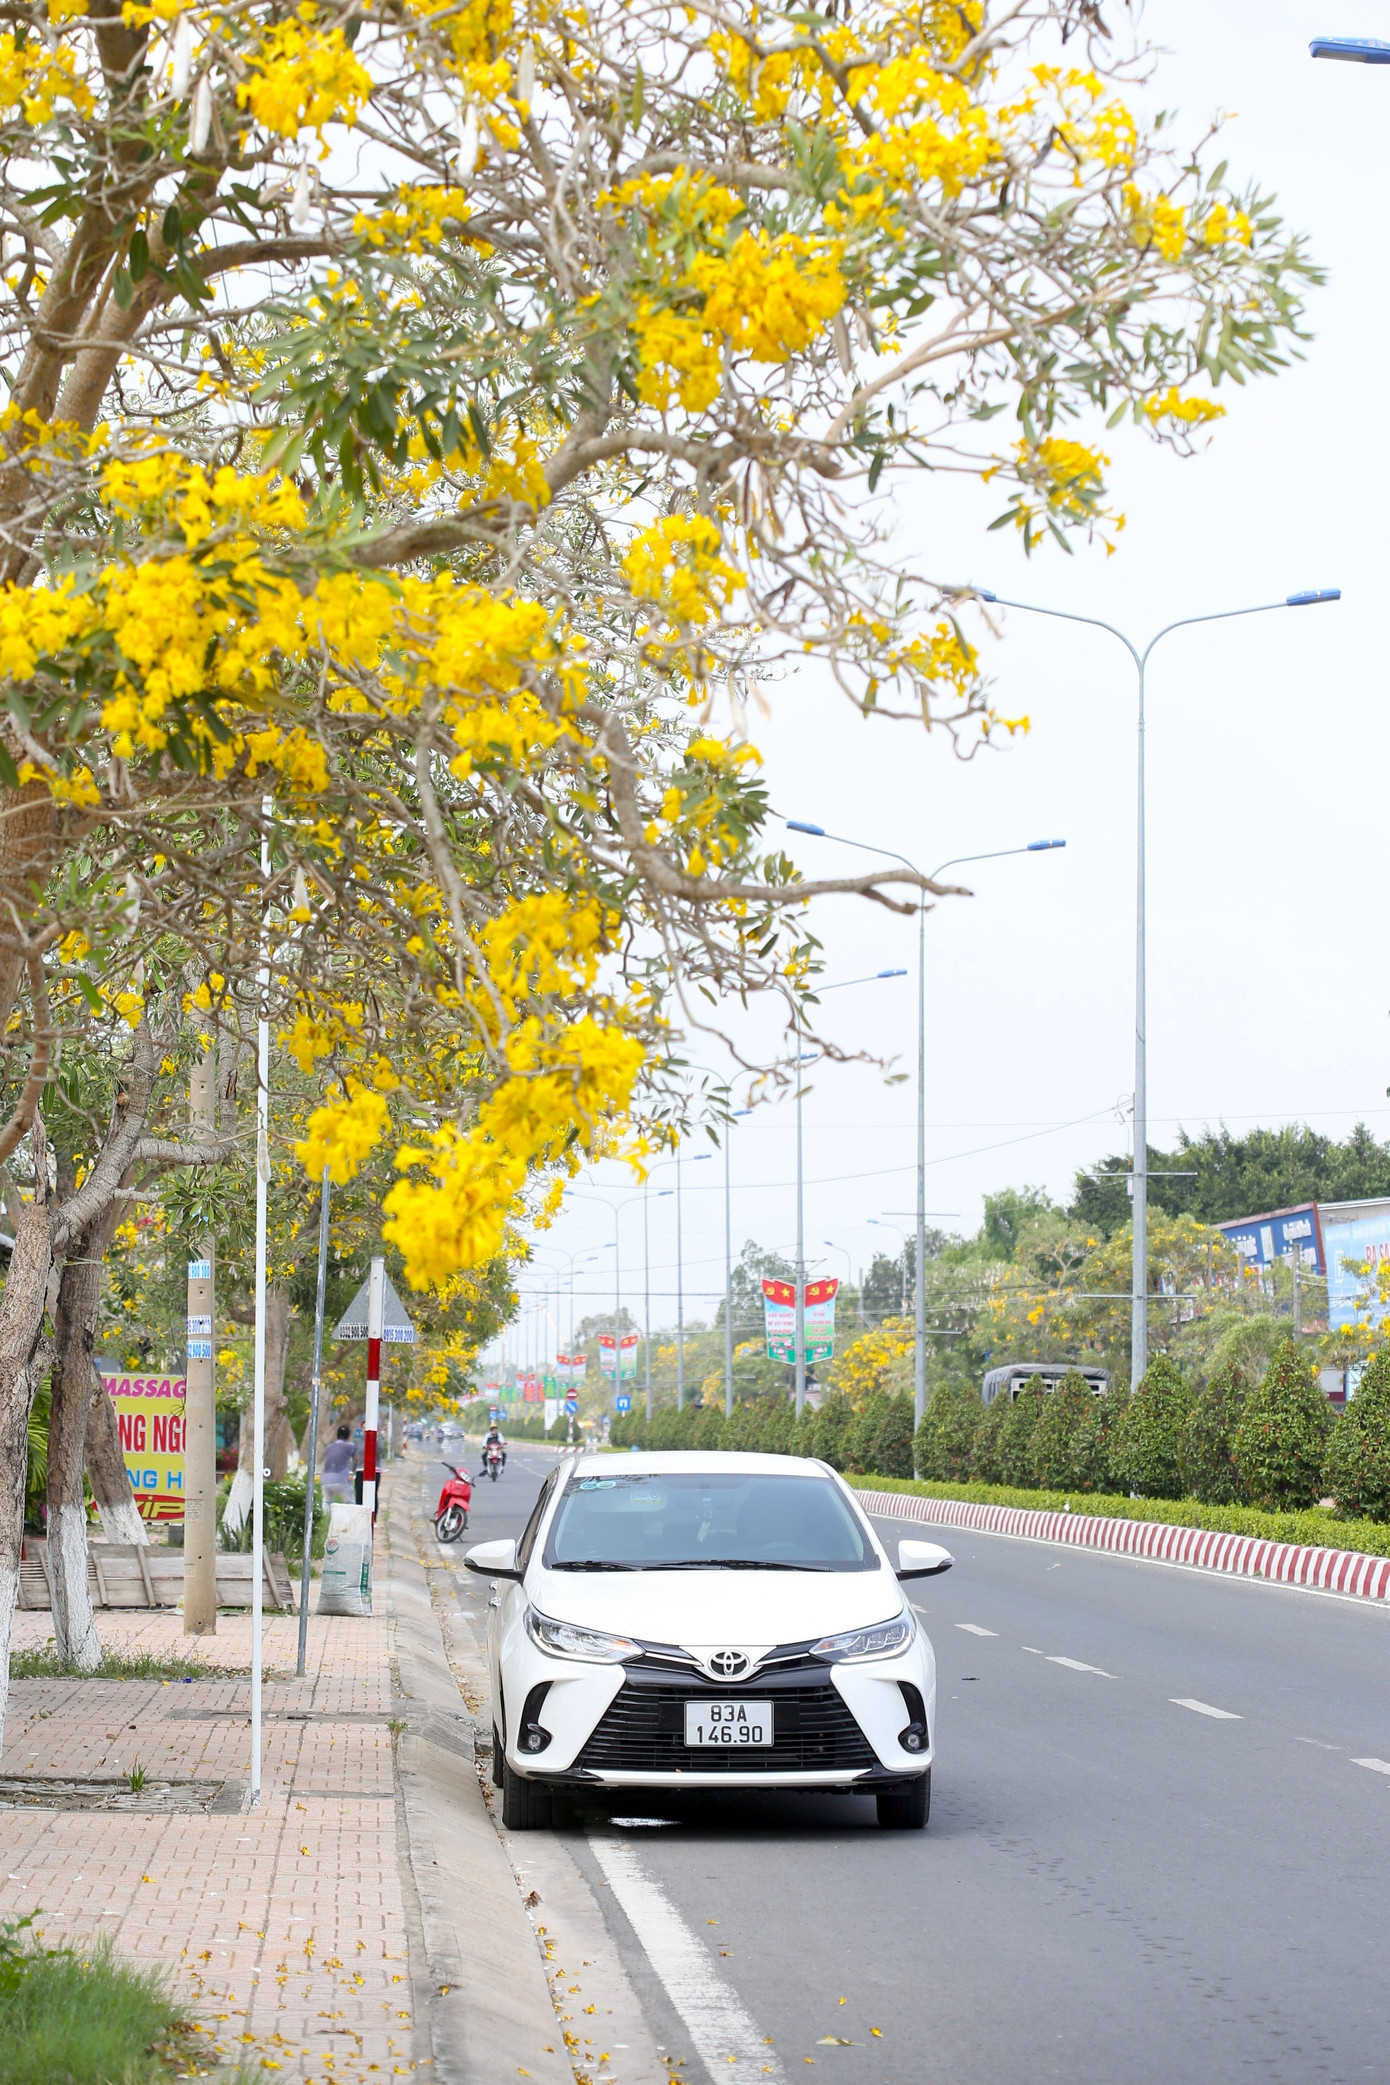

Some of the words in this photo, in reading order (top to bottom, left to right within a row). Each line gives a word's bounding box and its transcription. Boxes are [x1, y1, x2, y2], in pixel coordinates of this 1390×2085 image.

[102, 1378, 186, 1398] MASSAG
[710, 1704, 748, 1723] 83A
[696, 1725, 763, 1744] 146.90
